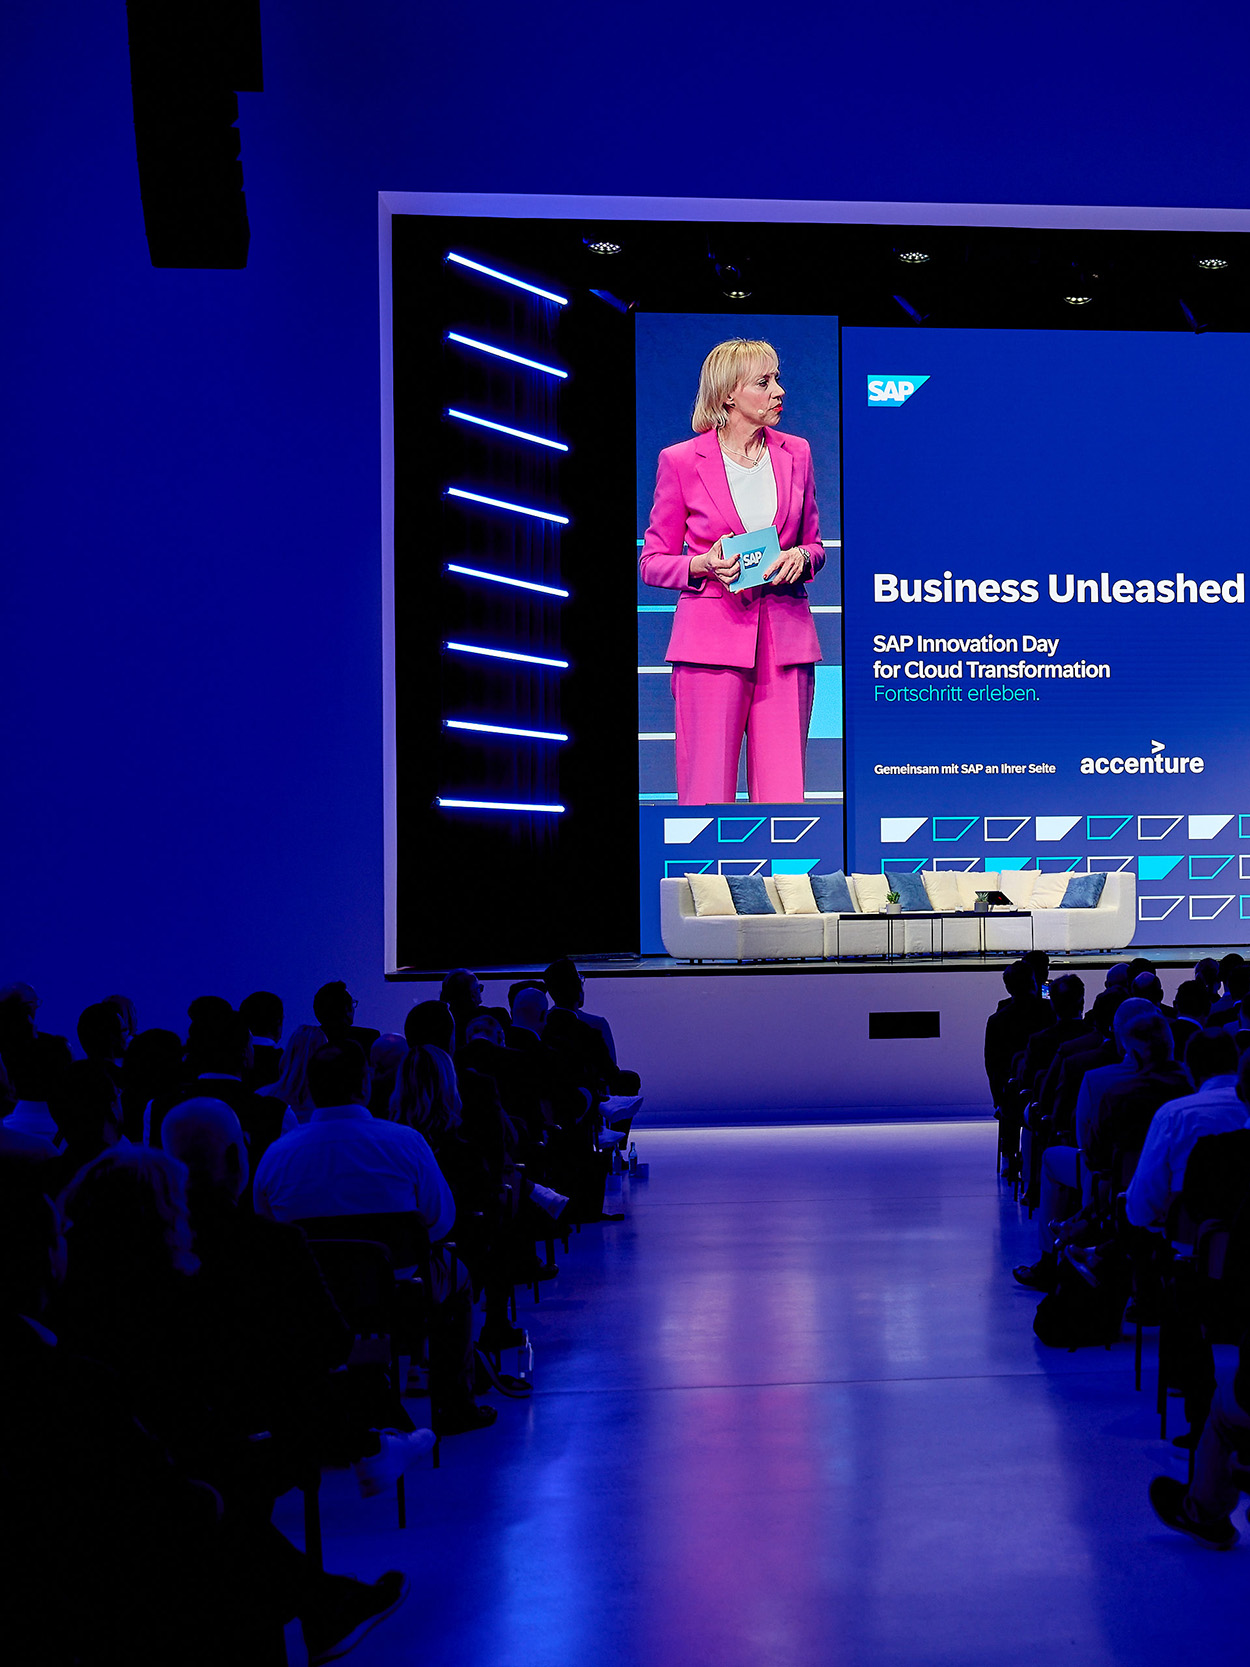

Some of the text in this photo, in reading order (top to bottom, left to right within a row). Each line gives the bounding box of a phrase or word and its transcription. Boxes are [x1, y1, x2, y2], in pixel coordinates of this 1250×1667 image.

[868, 380, 915, 402] SAP
[743, 551, 763, 567] SAP
[873, 570, 1245, 604] Business Unleashed
[873, 633, 1060, 658] SAP Innovation Day
[872, 659, 1111, 679] for Cloud Transformation
[874, 684, 1040, 702] Fortschritt erleben.
[873, 762, 1057, 775] Gemeinsam mit SAP an Ihrer Seite
[1080, 753, 1205, 775] accenture
